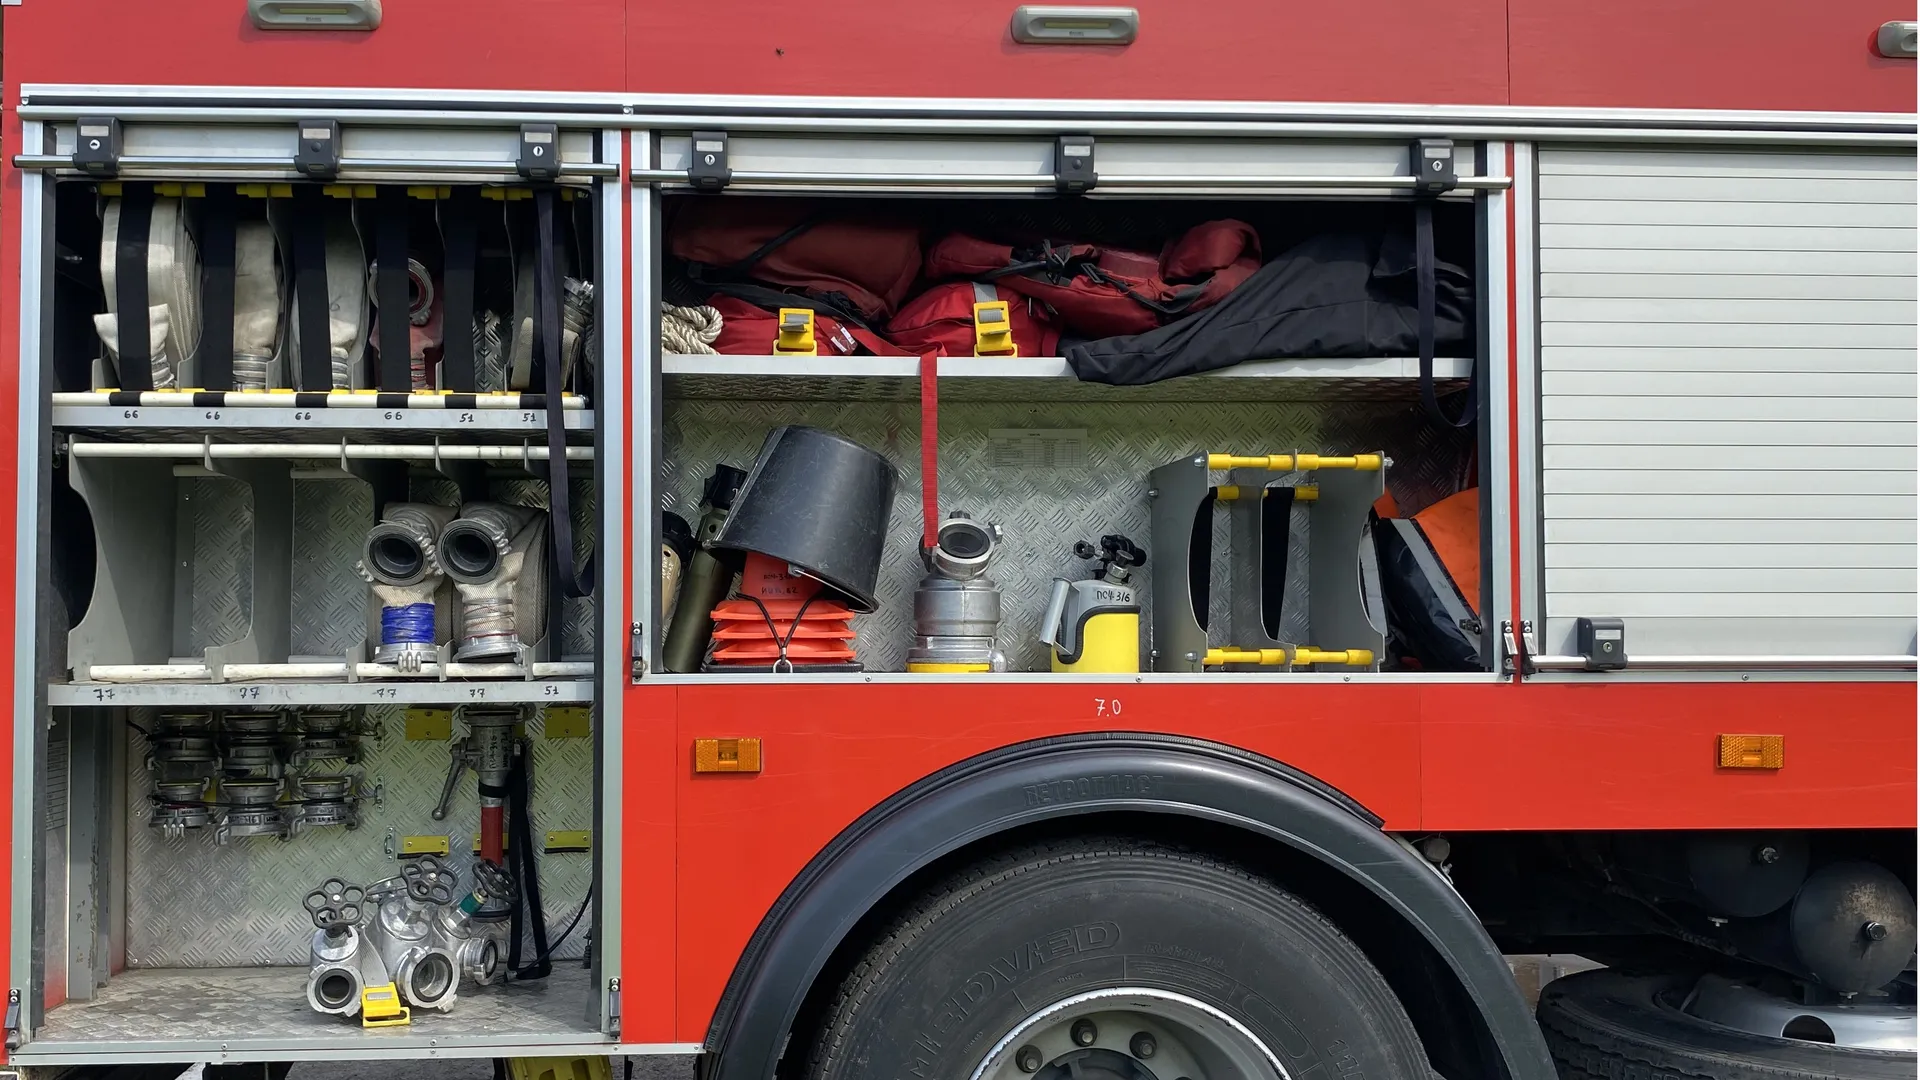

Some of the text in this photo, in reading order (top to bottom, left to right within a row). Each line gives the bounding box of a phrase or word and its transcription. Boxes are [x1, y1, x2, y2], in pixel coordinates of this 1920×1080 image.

[123, 409, 139, 419] 66
[205, 411, 221, 421] 66
[294, 411, 312, 421] 66
[383, 411, 403, 421] 66
[458, 412, 475, 423] 51
[522, 412, 537, 423] 51
[92, 688, 116, 702] 77
[239, 686, 260, 700] 77
[376, 687, 397, 699] 77
[469, 687, 486, 699] 77
[544, 685, 560, 696] 51
[1095, 698, 1121, 717] 7.0
